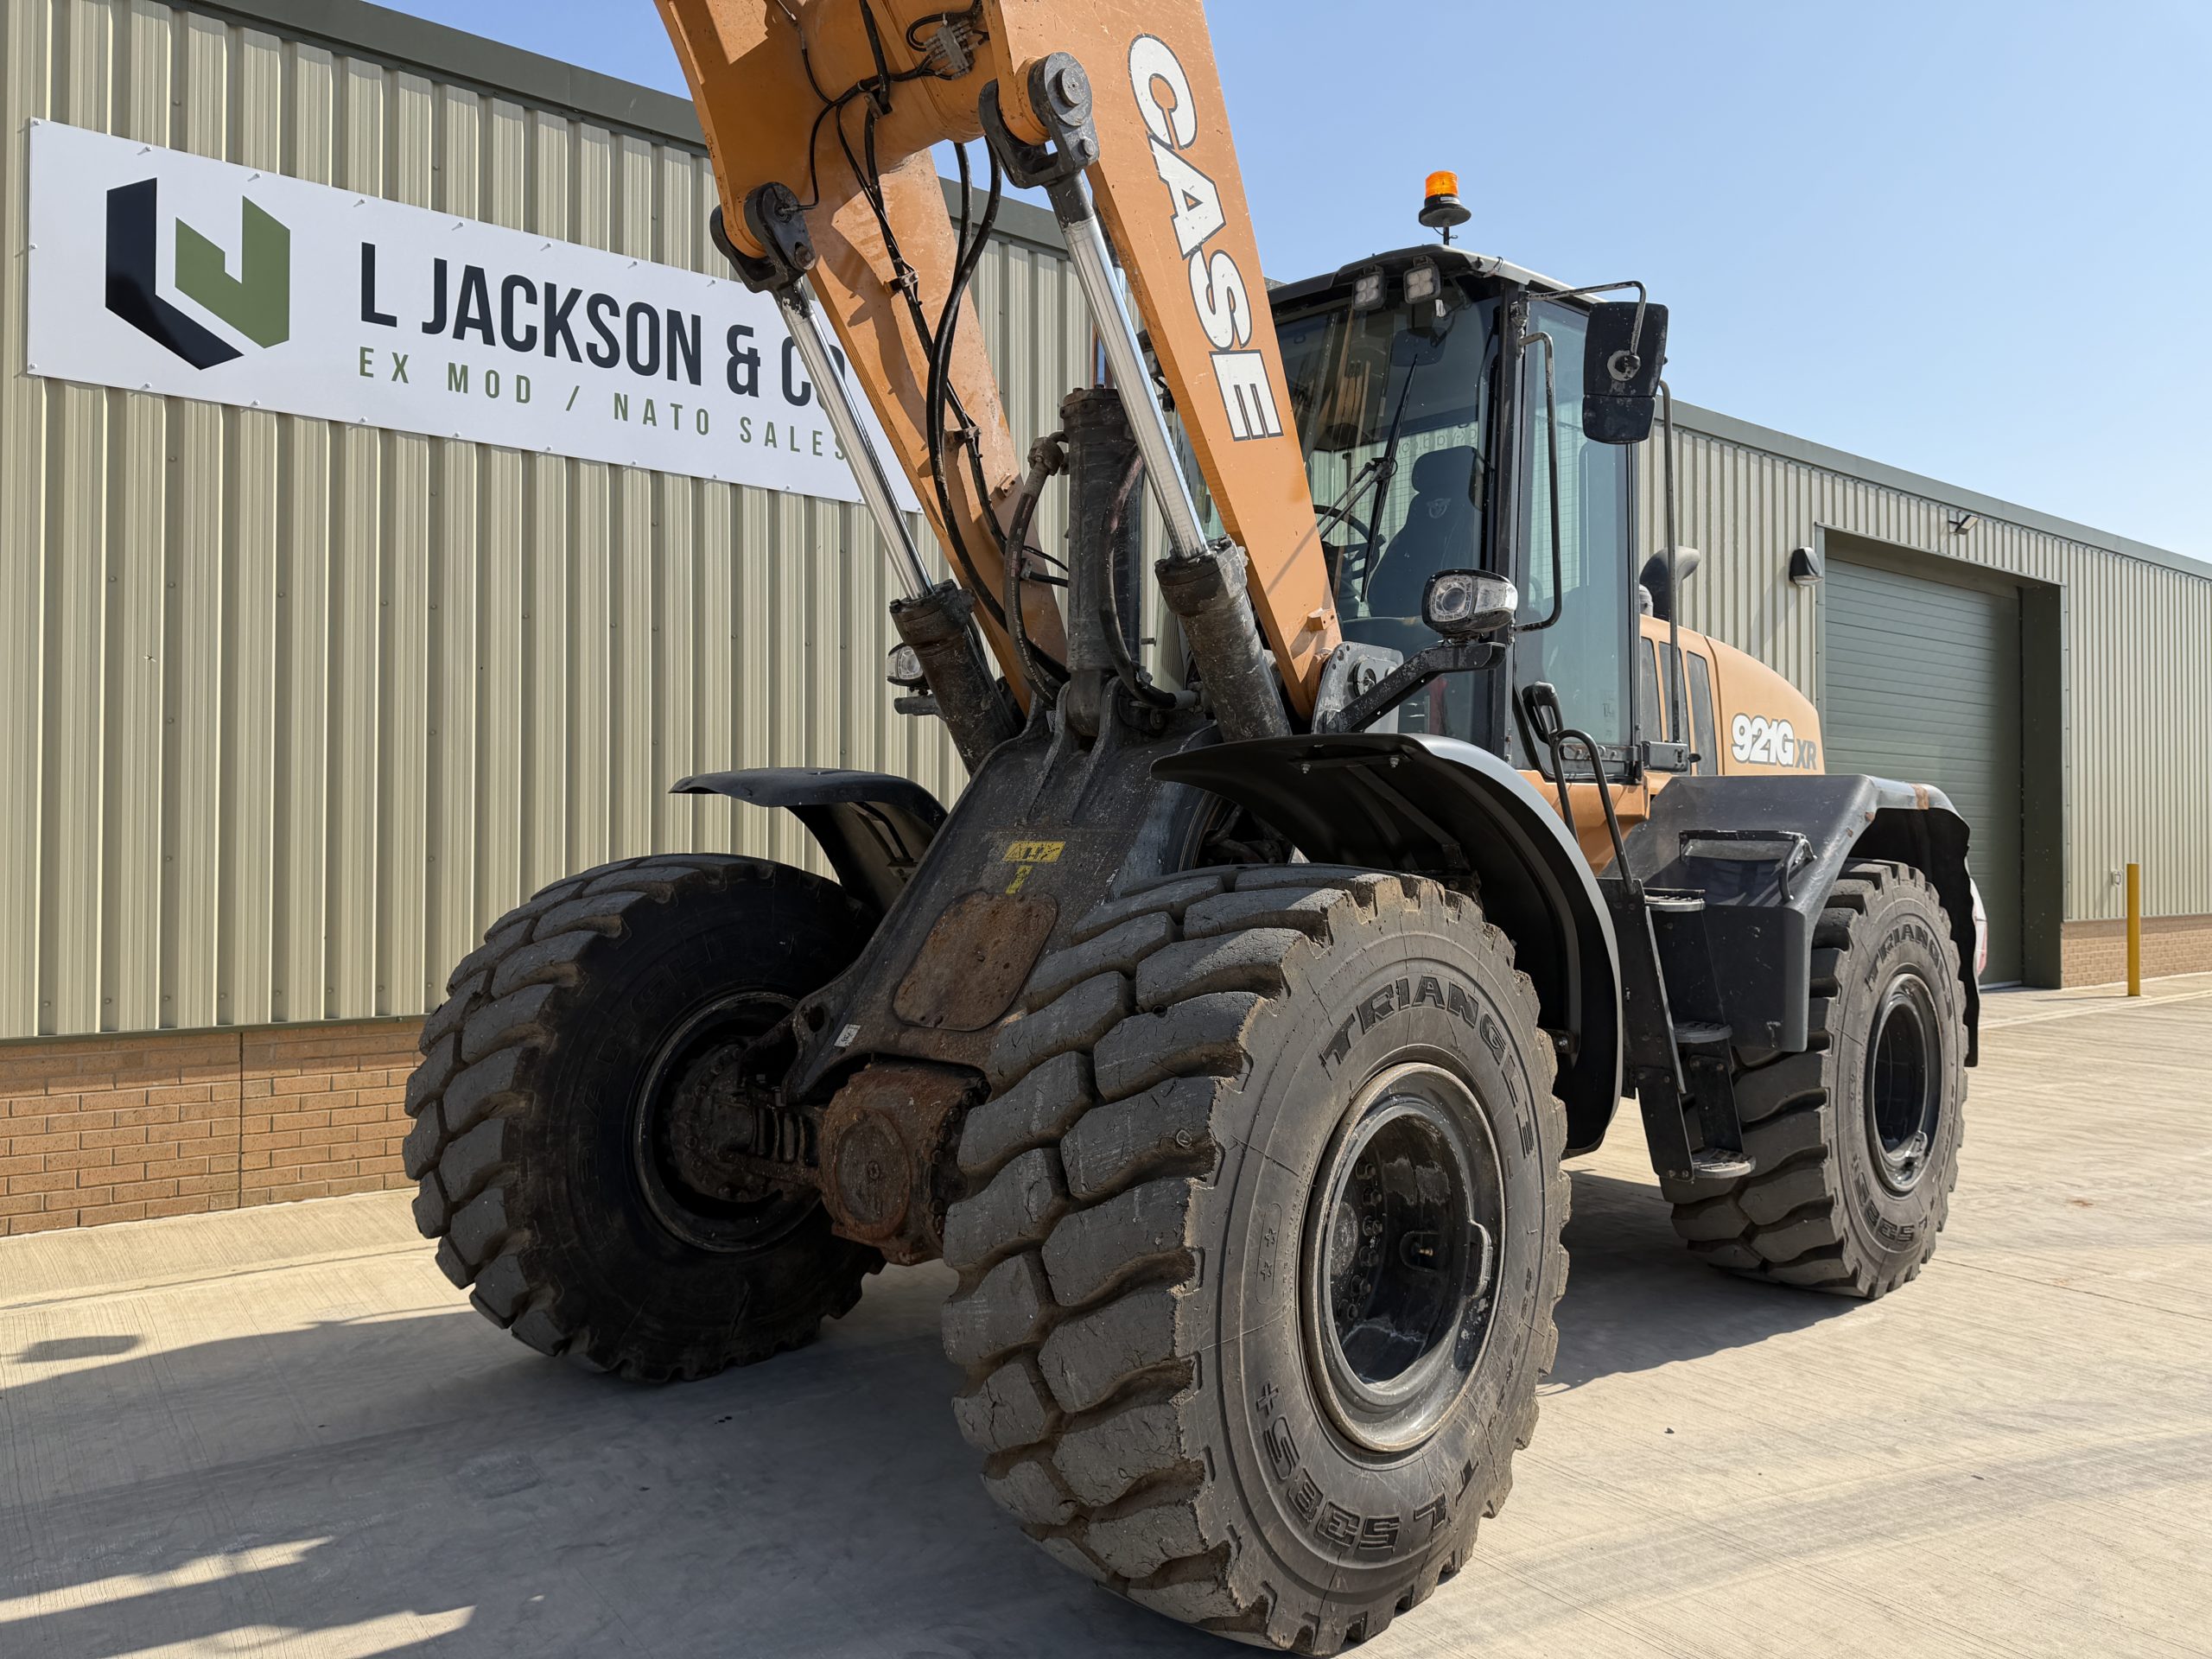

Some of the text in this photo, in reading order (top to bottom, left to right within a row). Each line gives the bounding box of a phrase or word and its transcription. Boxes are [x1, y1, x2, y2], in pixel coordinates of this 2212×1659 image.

[1128, 33, 1283, 442] CASE
[361, 241, 397, 328] L
[422, 257, 702, 387] JACKSON
[727, 324, 760, 398] &
[359, 346, 410, 385] EX
[448, 361, 531, 404] MOD
[613, 392, 709, 435] NATO
[740, 416, 846, 461] SALES
[1732, 713, 1817, 770] 921G XR
[1319, 975, 1534, 1159] TRIANGLE
